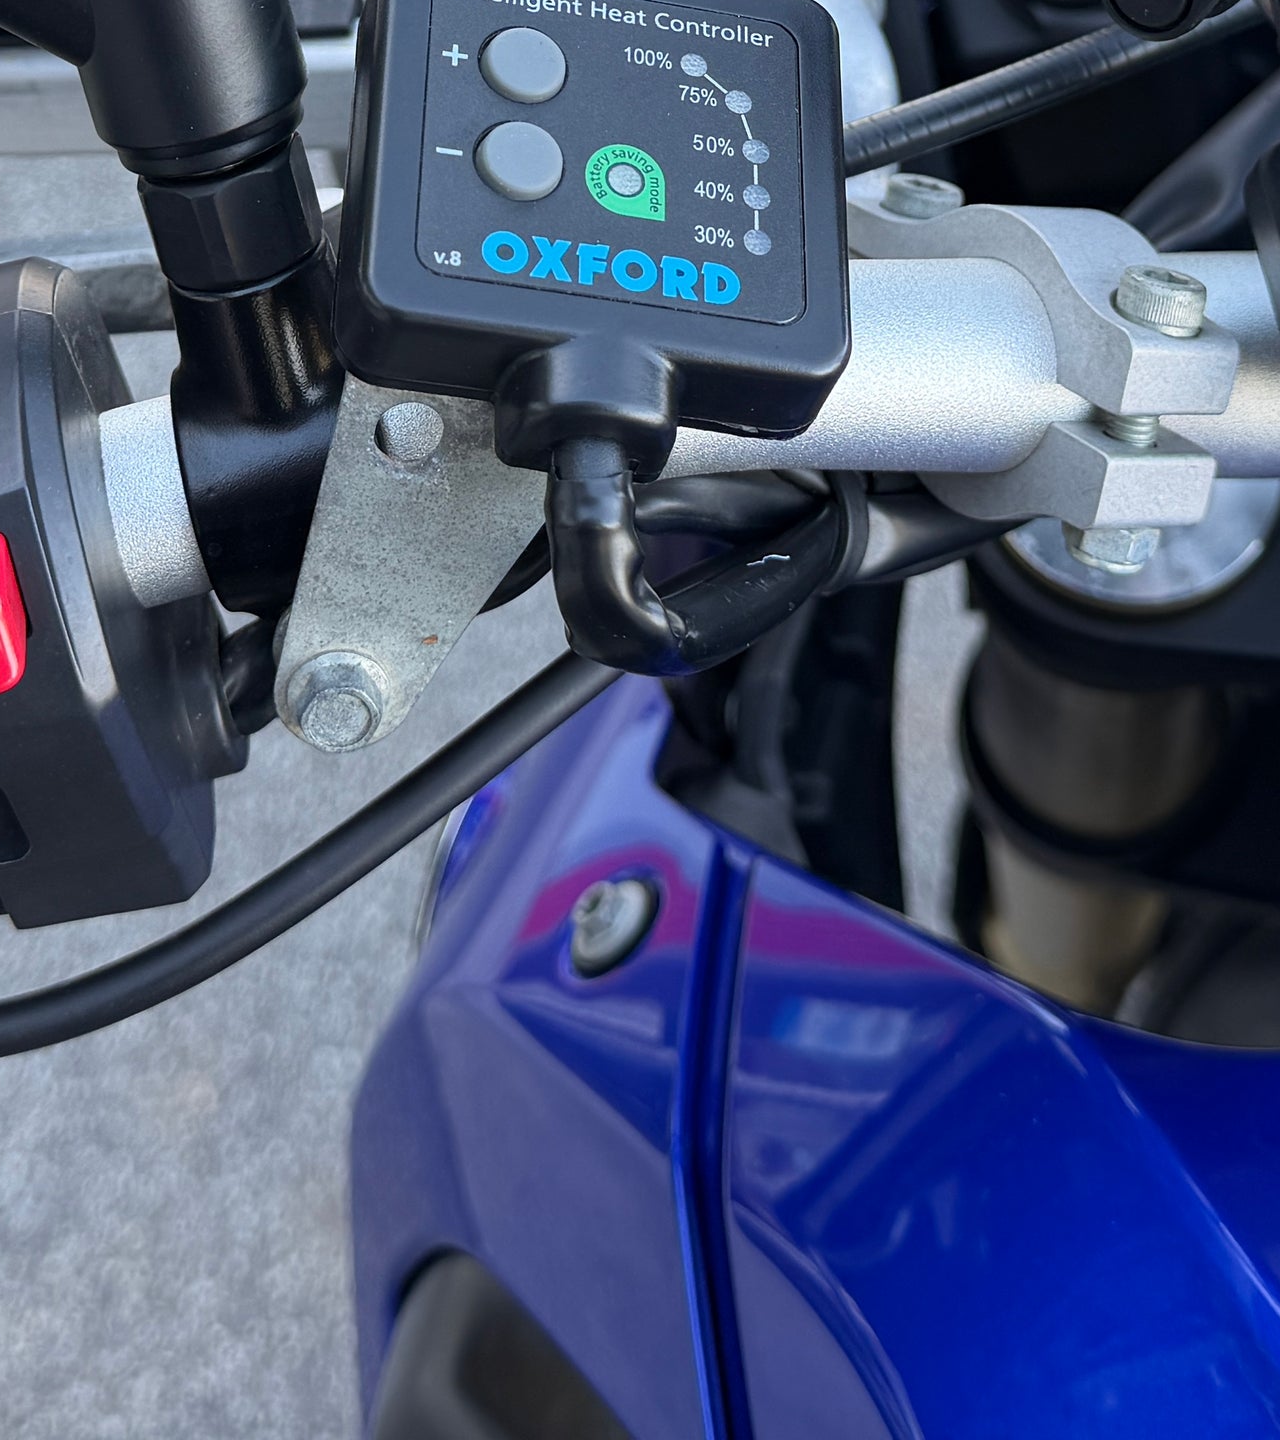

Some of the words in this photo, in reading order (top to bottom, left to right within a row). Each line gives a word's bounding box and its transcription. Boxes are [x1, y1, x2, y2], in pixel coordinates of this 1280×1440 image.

[590, 0, 647, 28] Heat
[653, 12, 775, 48] Controller
[623, 46, 673, 70] 100%
[678, 84, 718, 107] 75%
[692, 133, 735, 157] 50%
[589, 153, 611, 200] Battery
[611, 149, 655, 174] saving
[649, 176, 663, 213] mode
[693, 180, 735, 203] 40%
[693, 224, 735, 248] 30%
[433, 249, 463, 267] v.8
[481, 230, 741, 305] OXFORD
